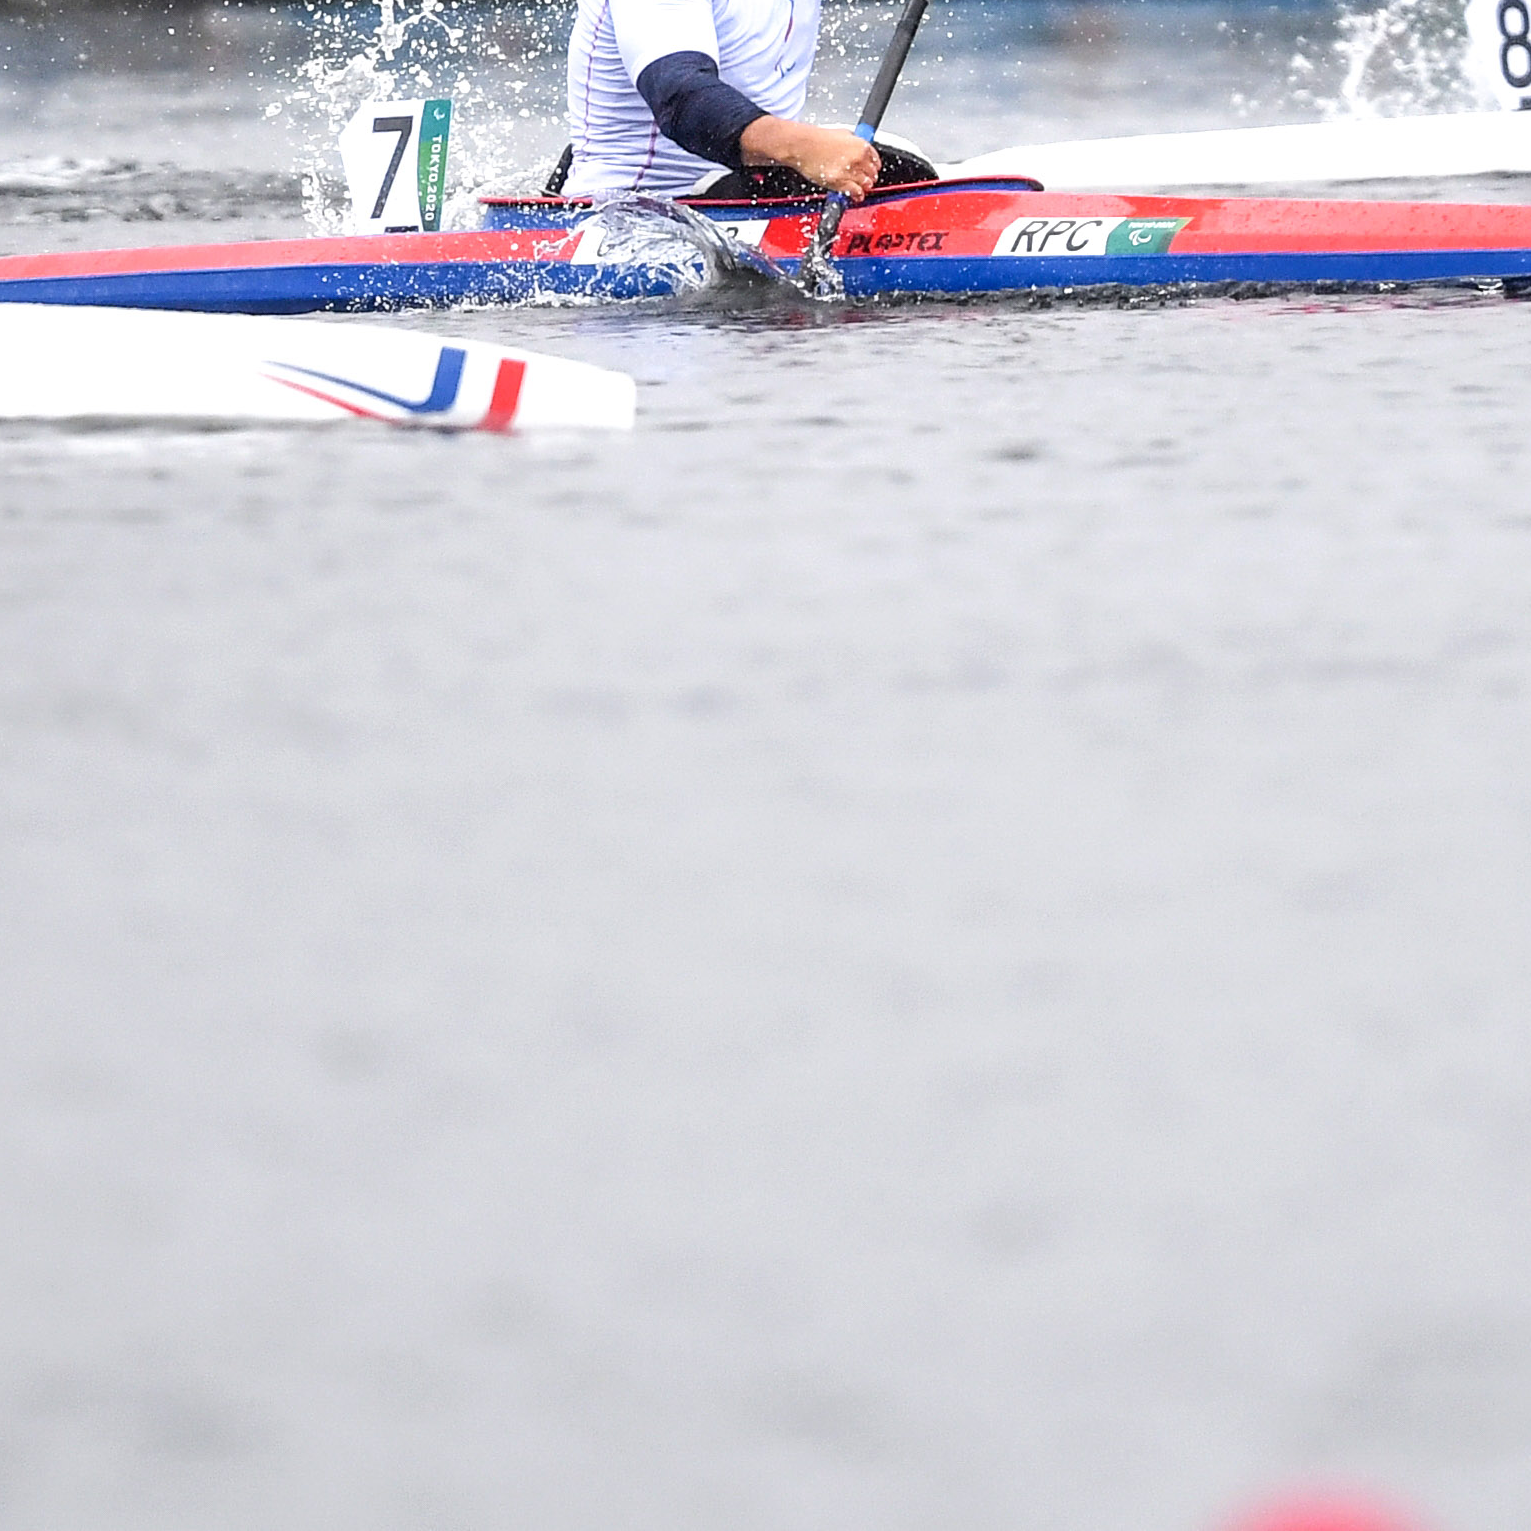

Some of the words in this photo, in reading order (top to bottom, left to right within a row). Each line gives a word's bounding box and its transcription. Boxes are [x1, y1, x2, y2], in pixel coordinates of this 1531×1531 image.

[370, 116, 413, 219] 7
[428, 134, 443, 182] TOKYO
[424, 185, 438, 221] 2020
[1010, 220, 1103, 253] RPC
